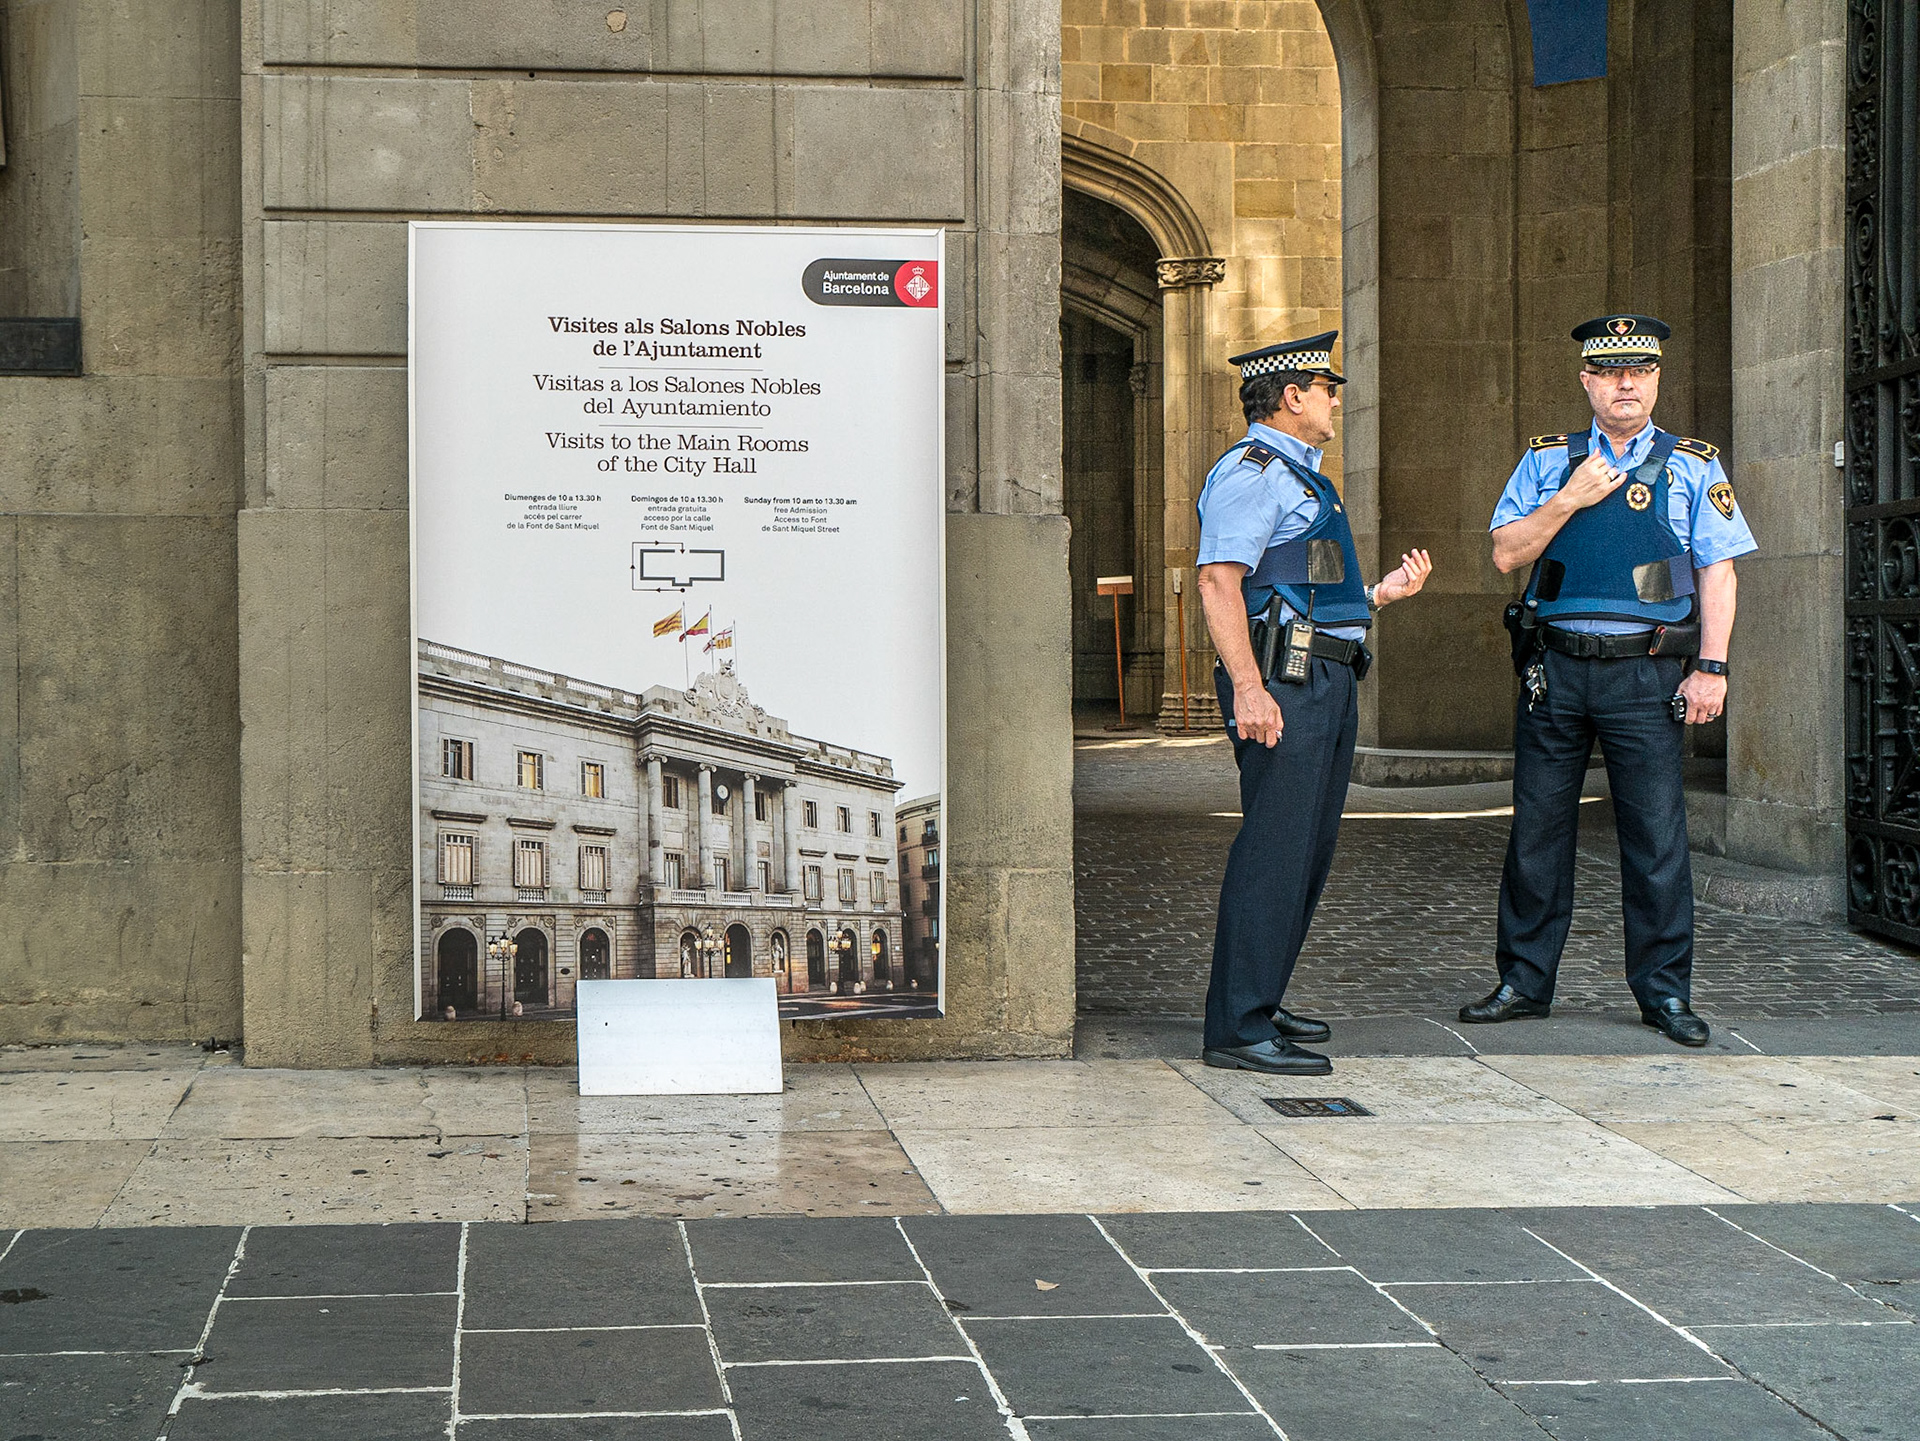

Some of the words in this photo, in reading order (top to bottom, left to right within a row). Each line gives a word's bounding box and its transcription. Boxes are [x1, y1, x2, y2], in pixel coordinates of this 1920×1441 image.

[823, 270, 877, 282] Ajuntament
[877, 272, 890, 282] de
[822, 281, 890, 296] Barcelona
[547, 315, 619, 334] Visites
[624, 316, 655, 336] als
[660, 317, 730, 337] Salons
[735, 319, 807, 338] Nobles
[592, 339, 617, 358] de
[622, 339, 763, 362] l’Ajuntament
[532, 373, 605, 392] Visitas
[610, 379, 624, 393] a
[628, 374, 659, 393] los
[664, 375, 745, 395] Salones
[750, 377, 821, 396] Nobles
[583, 396, 615, 416] del
[620, 397, 772, 419] Ayuntamiento
[544, 431, 605, 450] Visits
[610, 433, 632, 451] to
[637, 432, 672, 451] the
[677, 433, 732, 452] Main
[737, 434, 809, 453] Rooms
[597, 454, 620, 473] of
[624, 454, 658, 473] the
[663, 455, 707, 478] City
[712, 456, 758, 474] Hall
[504, 493, 546, 503] Diumenges
[546, 494, 557, 502] de
[558, 494, 568, 502] 10
[575, 494, 596, 502] 13.30
[596, 494, 602, 502] h
[630, 495, 668, 504] Domingos
[669, 495, 679, 503] de
[680, 495, 690, 503] 10
[697, 495, 718, 504] 13.30
[743, 496, 772, 506] Sunday
[772, 496, 791, 505] from
[792, 497, 801, 505] 10
[824, 497, 845, 505] 13.30
[528, 503, 558, 511] entrada
[558, 503, 578, 511] lliure
[647, 504, 677, 513] entrada
[677, 505, 707, 514] gratuita
[773, 506, 789, 514] free
[789, 506, 828, 515] Admission
[523, 512, 546, 521] accés
[546, 512, 559, 522] pel
[643, 514, 670, 522] acceso
[670, 515, 683, 523] por
[684, 514, 692, 522] la
[692, 514, 712, 522] calle
[773, 515, 800, 524] Access
[801, 516, 810, 524] to
[810, 515, 827, 524] Font
[506, 522, 517, 530] de
[517, 522, 525, 530] la
[526, 521, 543, 530] Font
[543, 522, 554, 530] de
[555, 522, 573, 530] Sant
[573, 522, 600, 531] Miquel
[640, 523, 658, 531] Font
[658, 523, 669, 531] de
[669, 523, 687, 531] Sant
[688, 524, 714, 533] Miquel
[761, 524, 771, 533] de
[772, 524, 790, 533] Sant
[790, 525, 816, 534] Miquel
[817, 525, 840, 533] Street
